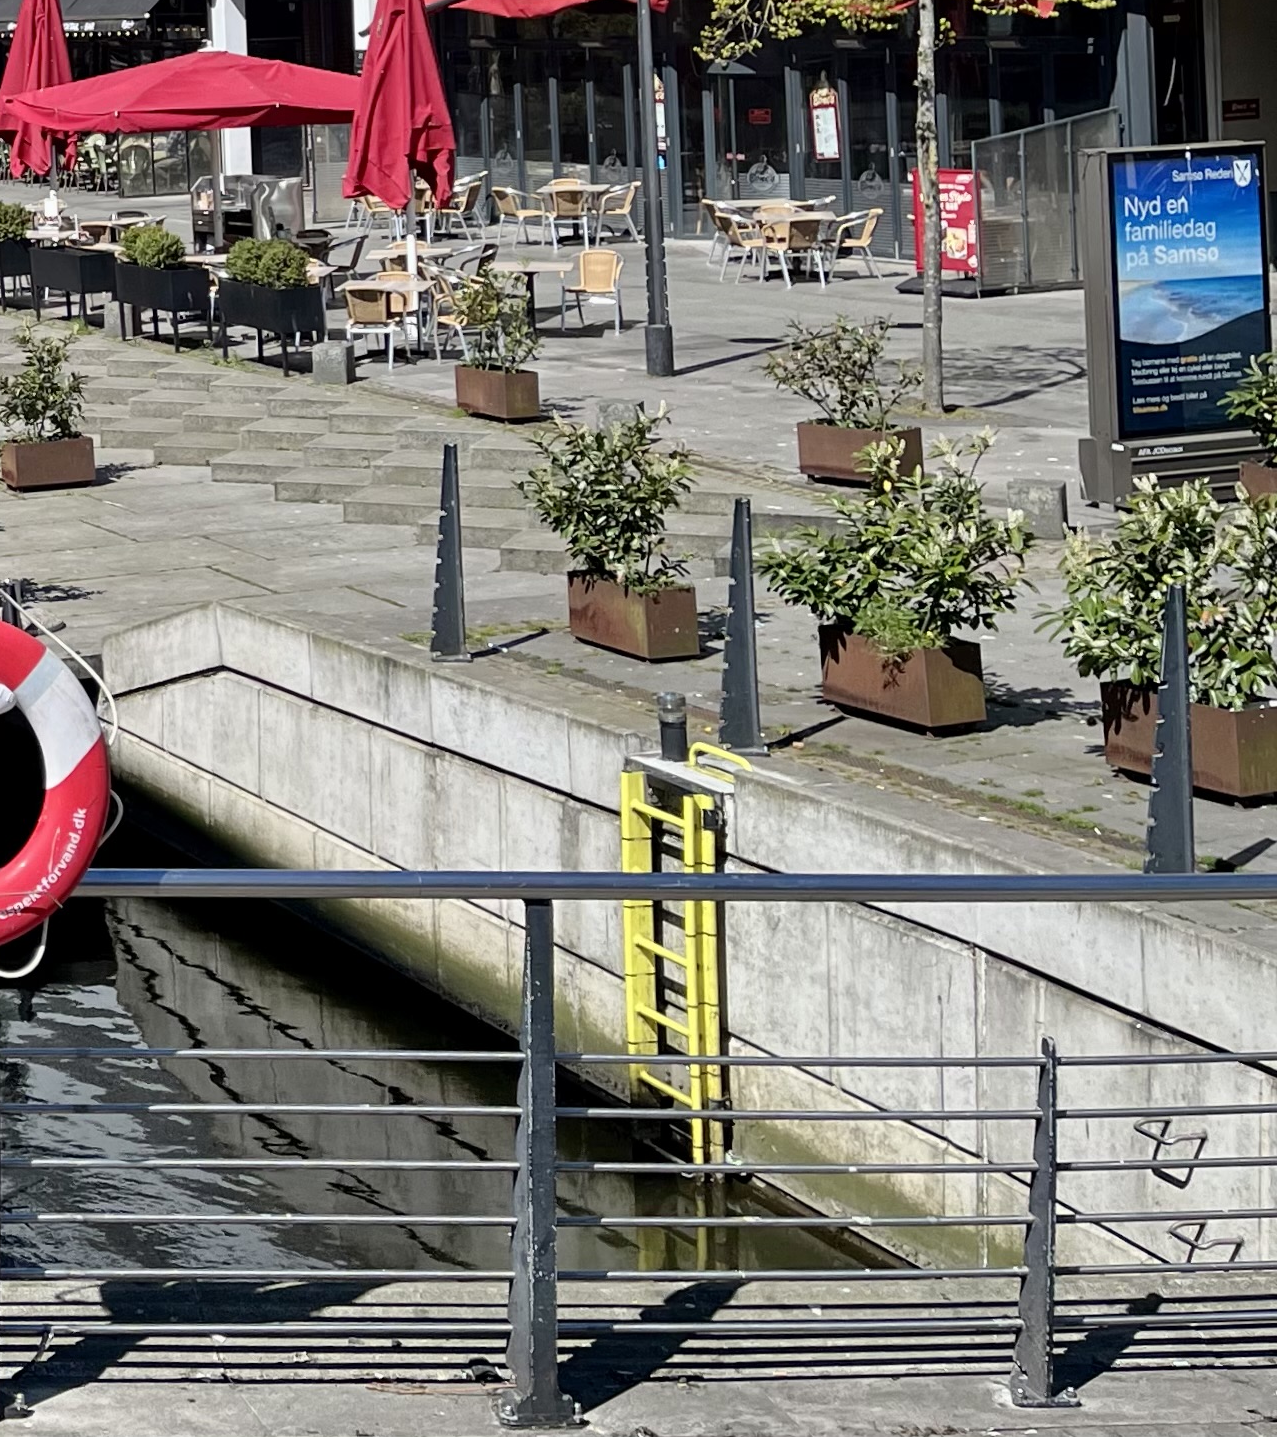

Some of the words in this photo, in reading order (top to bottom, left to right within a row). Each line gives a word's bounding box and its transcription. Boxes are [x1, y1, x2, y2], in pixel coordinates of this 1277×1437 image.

[1124, 195, 1161, 221] Nyd
[1166, 197, 1189, 215] en
[1125, 218, 1216, 242] familiedag
[1126, 244, 1149, 271] på
[1154, 245, 1219, 265] Samsø
